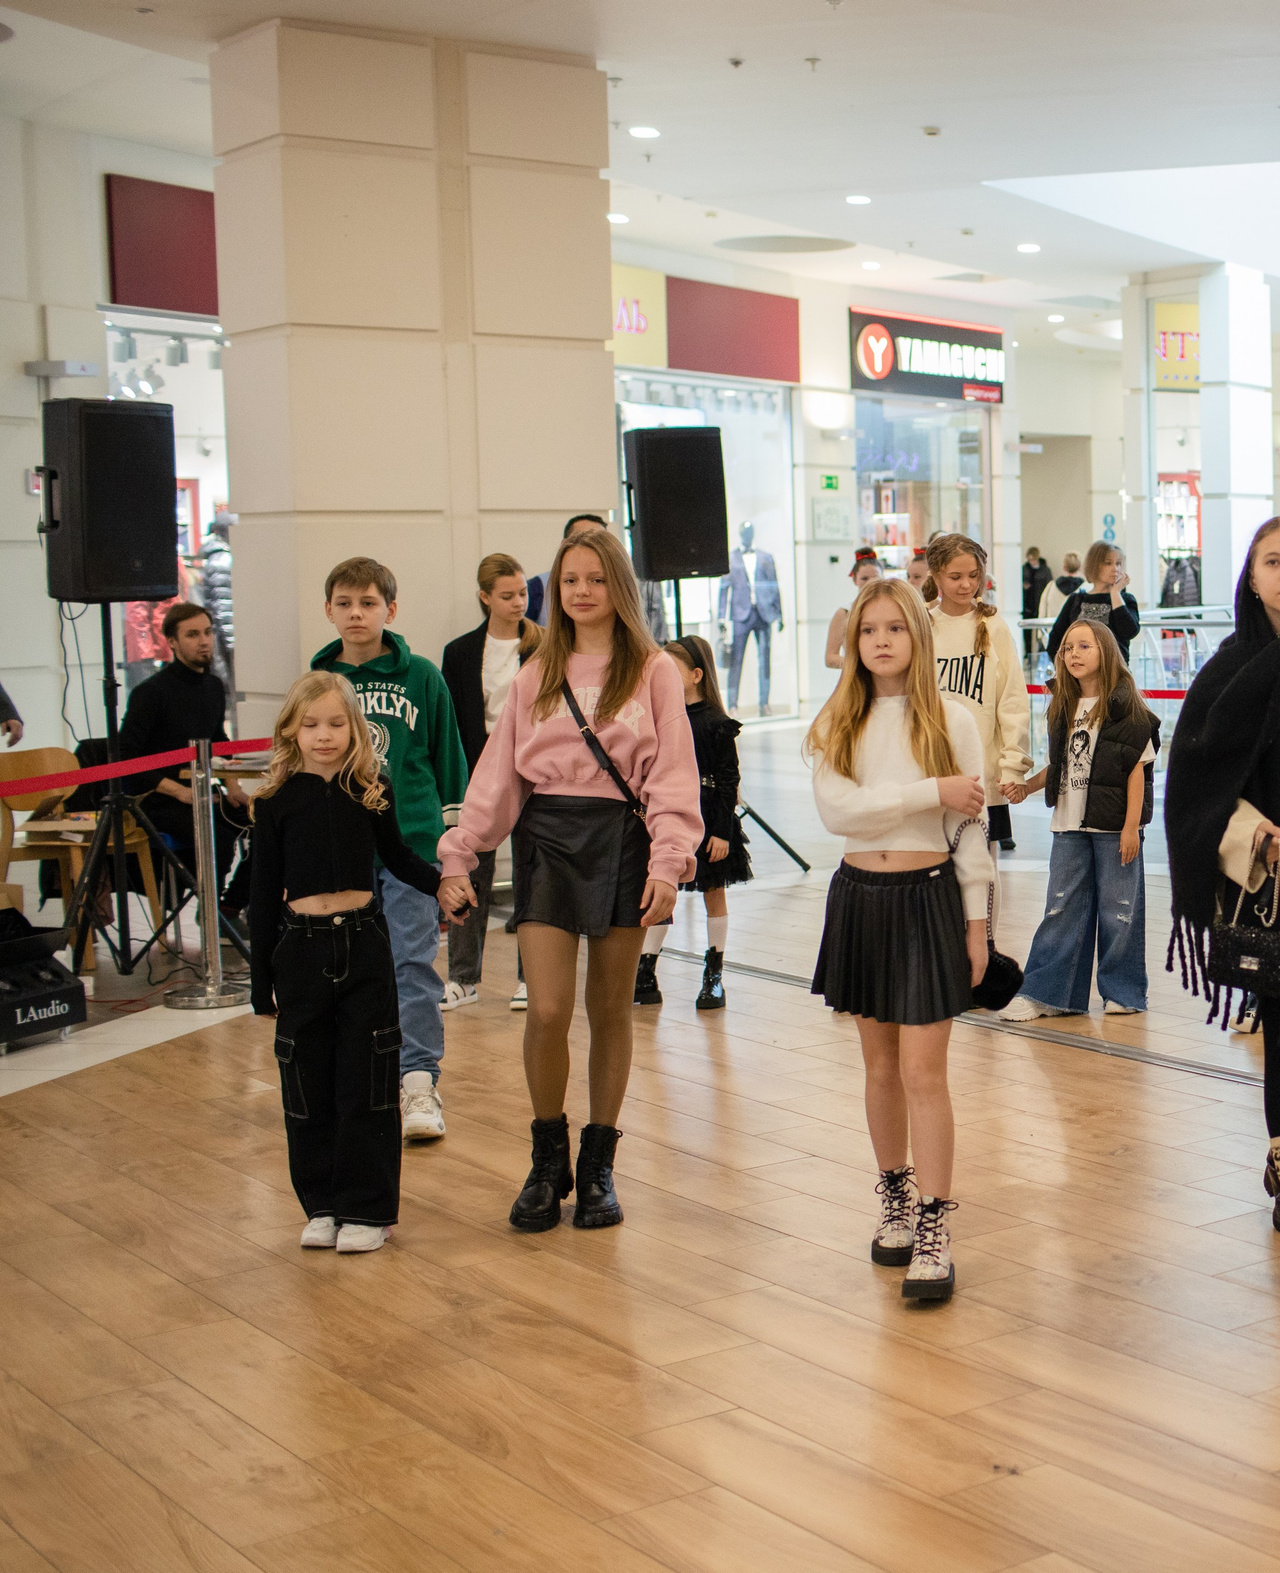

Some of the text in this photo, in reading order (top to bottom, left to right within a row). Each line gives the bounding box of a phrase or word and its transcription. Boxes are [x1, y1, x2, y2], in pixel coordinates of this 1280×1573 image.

[895, 336, 1005, 383] YAMAGUCHI
[367, 682, 407, 694] STATES
[937, 651, 986, 706] ZONA
[15, 1000, 70, 1025] LAudio
